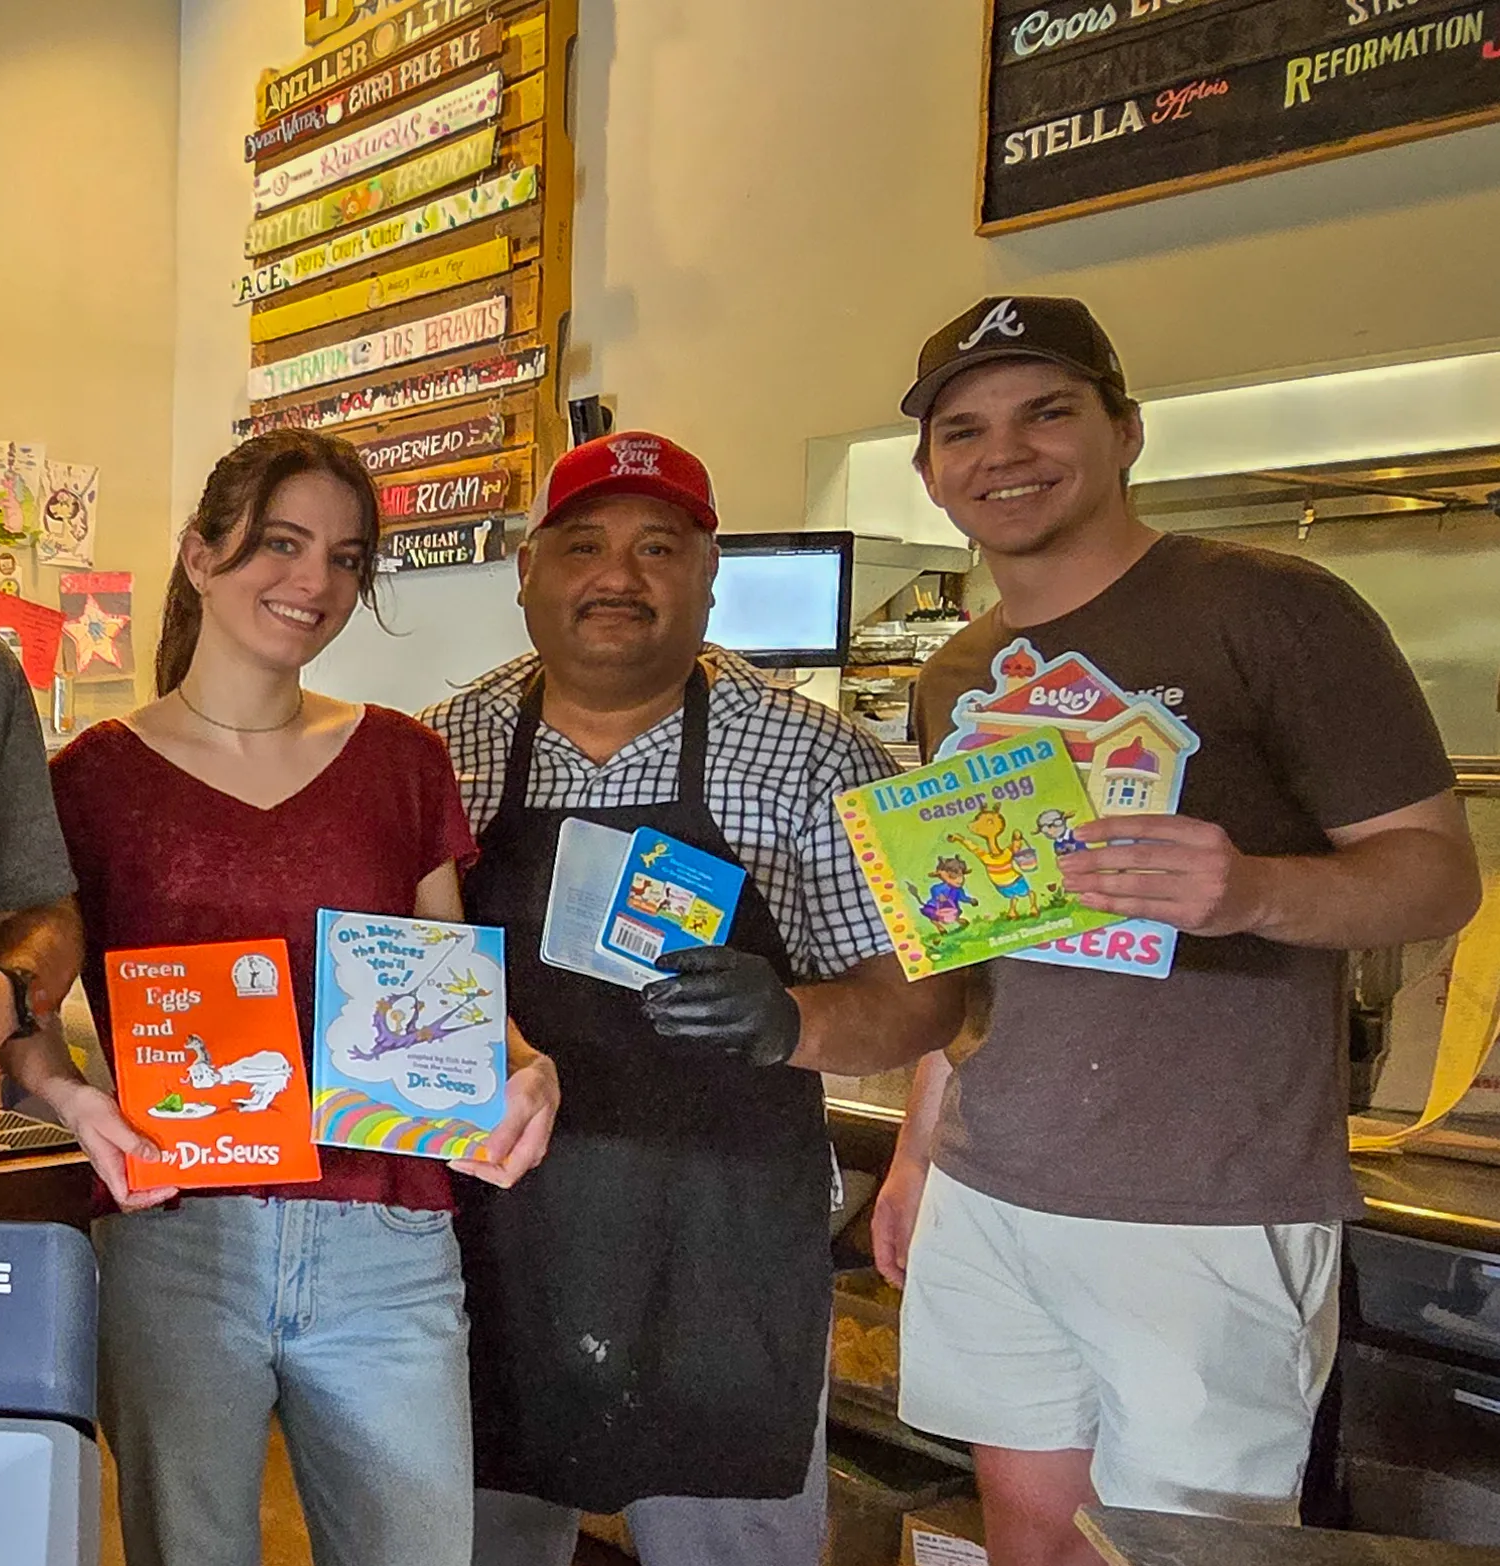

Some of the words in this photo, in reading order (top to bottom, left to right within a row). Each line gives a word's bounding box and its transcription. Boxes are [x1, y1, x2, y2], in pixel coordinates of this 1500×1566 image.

[1011, 4, 1117, 56] Coors
[348, 70, 393, 114] EXTRA
[400, 46, 442, 91] PALE
[450, 29, 480, 68] ALE
[1284, 10, 1485, 109] REFORMATION
[266, 41, 367, 117] MILLER
[1005, 101, 1147, 165] STELLA
[1152, 78, 1229, 124] Artois
[239, 263, 282, 301] ACE
[383, 328, 414, 360] LOS
[424, 303, 503, 351] BRAVOS
[958, 298, 1025, 350] A
[393, 530, 458, 556] BELGIAN
[874, 769, 960, 814] llama
[964, 739, 1056, 783] llama
[919, 790, 987, 825] easter
[990, 775, 1036, 806] egg
[119, 961, 186, 980] Green
[351, 945, 375, 958] the
[378, 970, 414, 987] Go!
[146, 987, 201, 1012] Eggs
[131, 1019, 174, 1037] and
[136, 1046, 186, 1065] Ham
[406, 1071, 432, 1089] Dr.
[433, 1072, 477, 1096] Seuss
[176, 1141, 214, 1170] Dr.
[216, 1135, 279, 1166] Seuss
